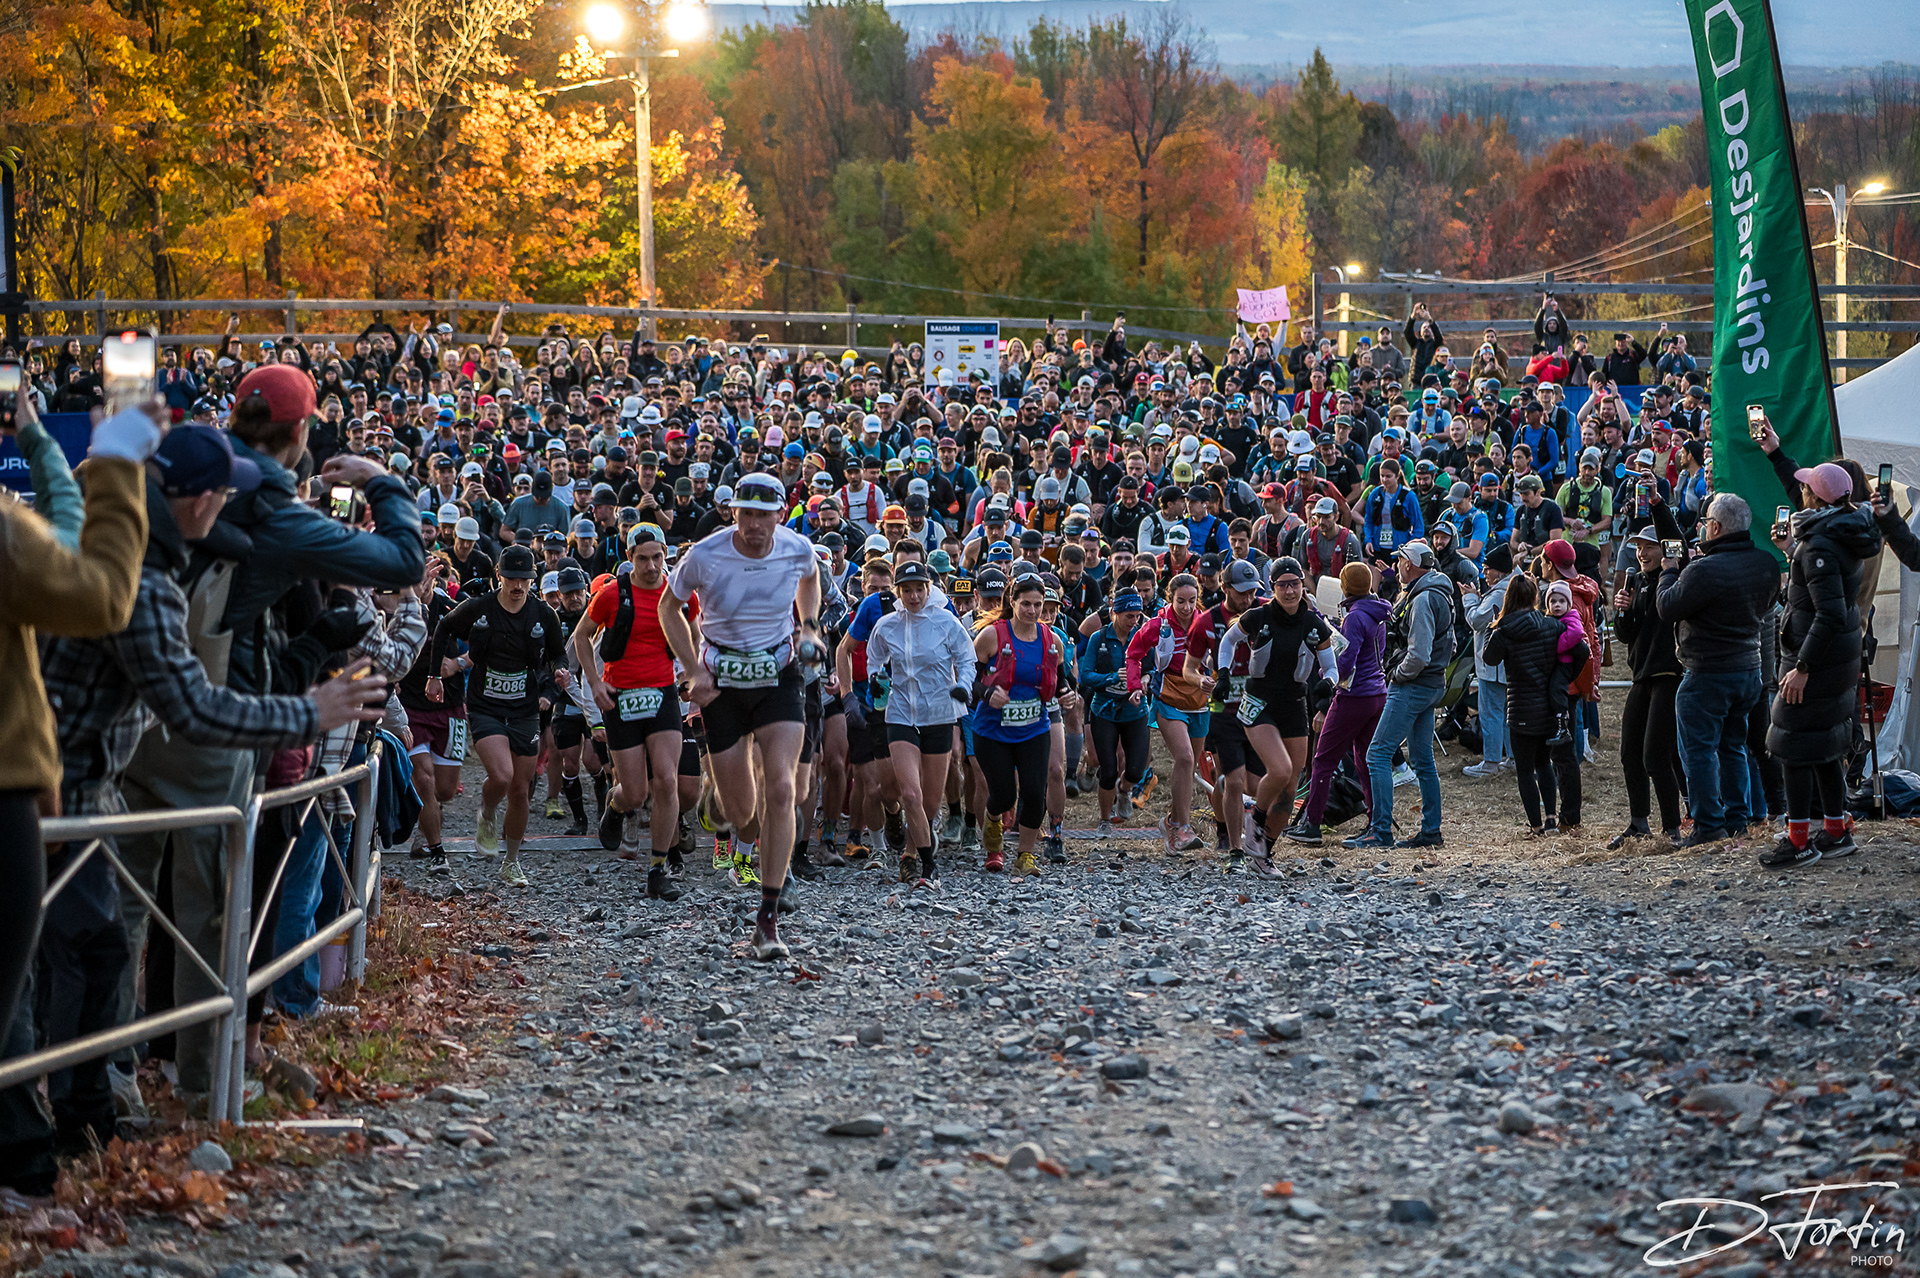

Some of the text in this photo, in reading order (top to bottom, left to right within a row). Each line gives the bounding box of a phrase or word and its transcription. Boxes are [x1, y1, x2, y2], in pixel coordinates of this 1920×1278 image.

[1720, 88, 1771, 374] Desjardins
[1244, 291, 1276, 303] LET'S
[1242, 300, 1282, 311] FUCKING
[986, 580, 1005, 588] HOKA
[721, 661, 777, 679] 12453
[486, 677, 526, 692] 12086
[1003, 705, 1041, 720] 12315
[1795, 848, 1814, 860] HOKA
